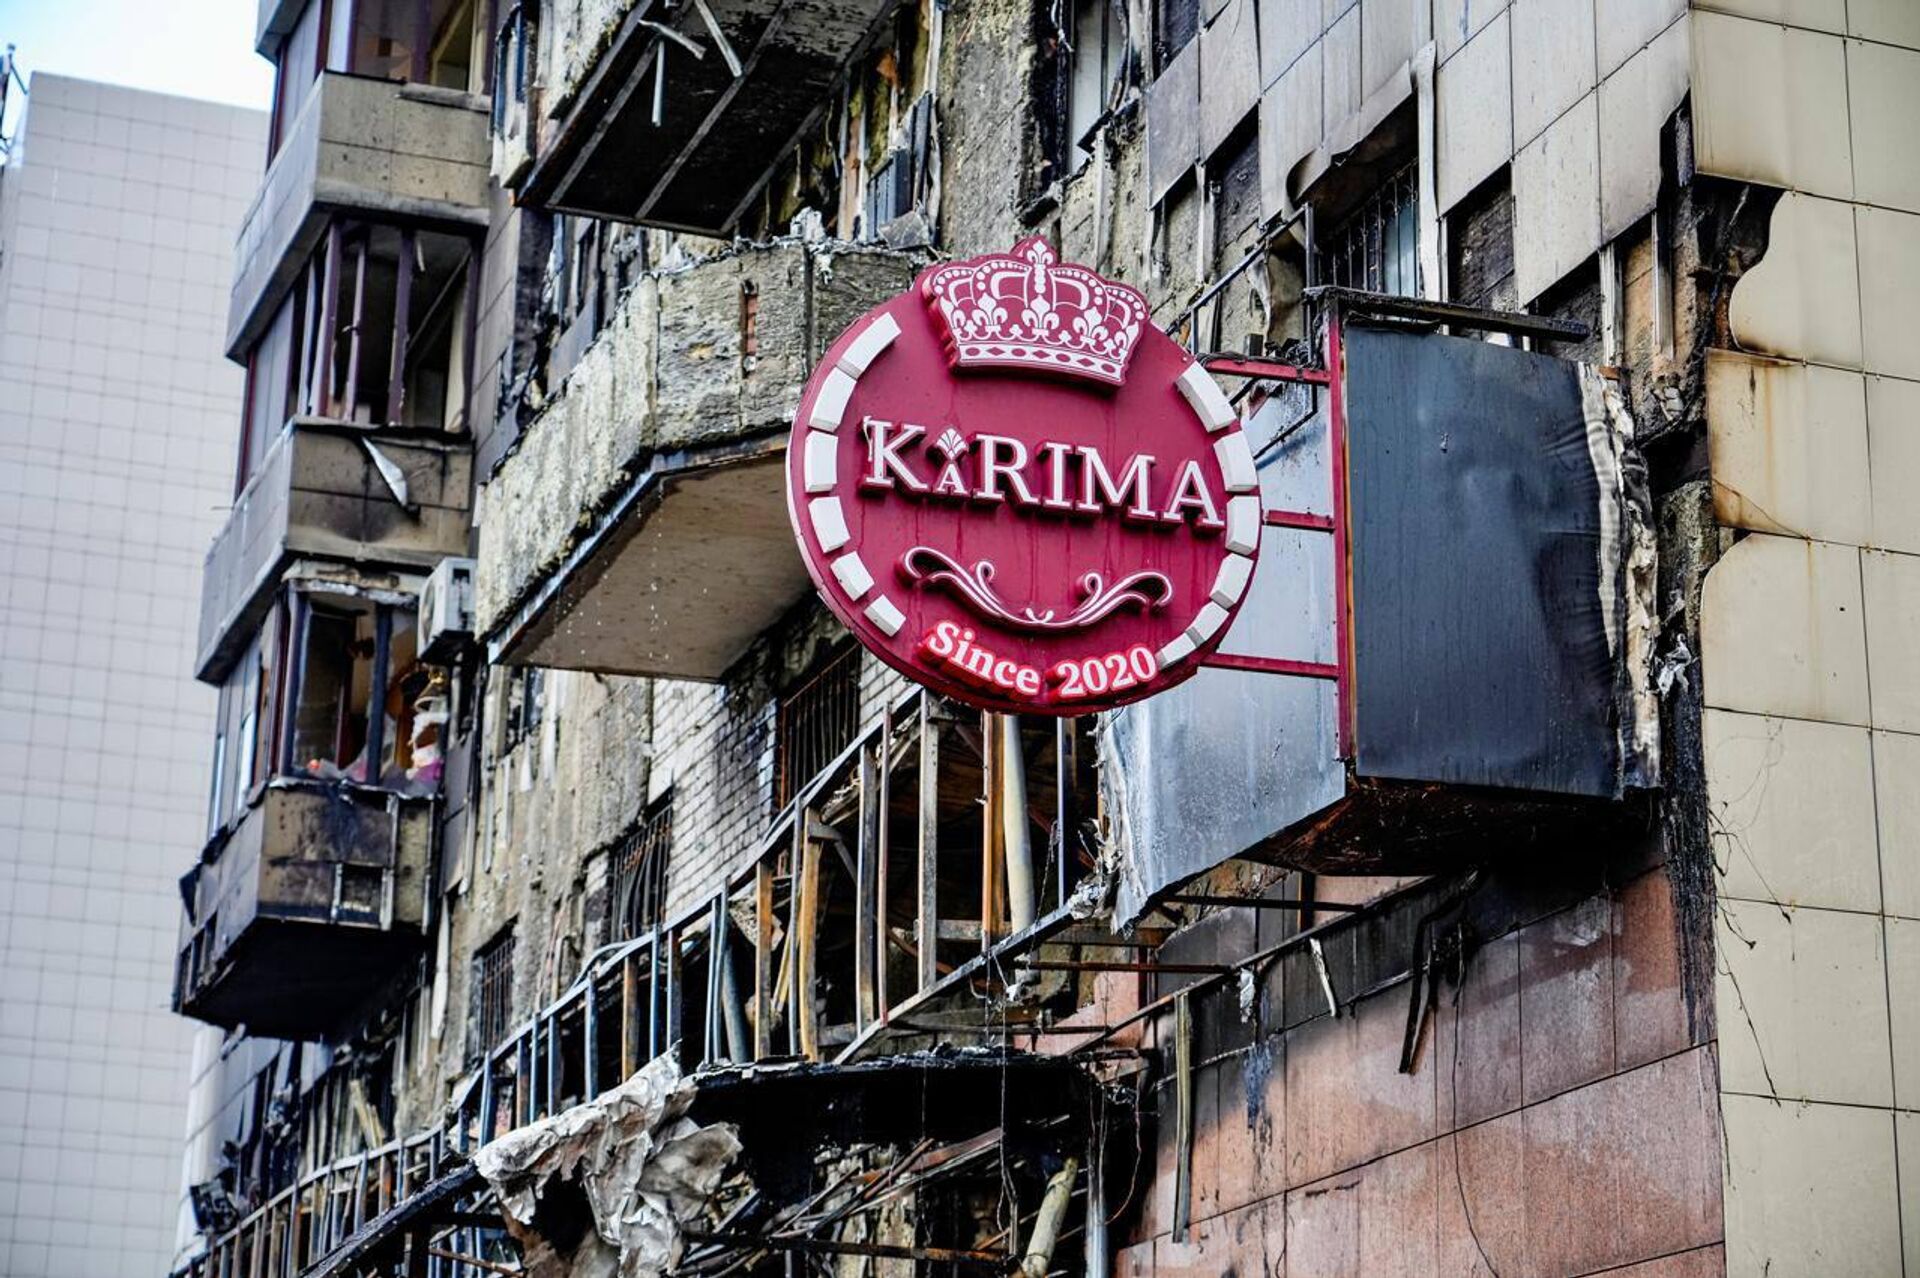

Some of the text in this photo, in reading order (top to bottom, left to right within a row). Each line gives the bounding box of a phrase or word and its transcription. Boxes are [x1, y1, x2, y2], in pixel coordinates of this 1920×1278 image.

[863, 416, 1225, 528] KARIMA
[927, 621, 1158, 698] Since 2020
